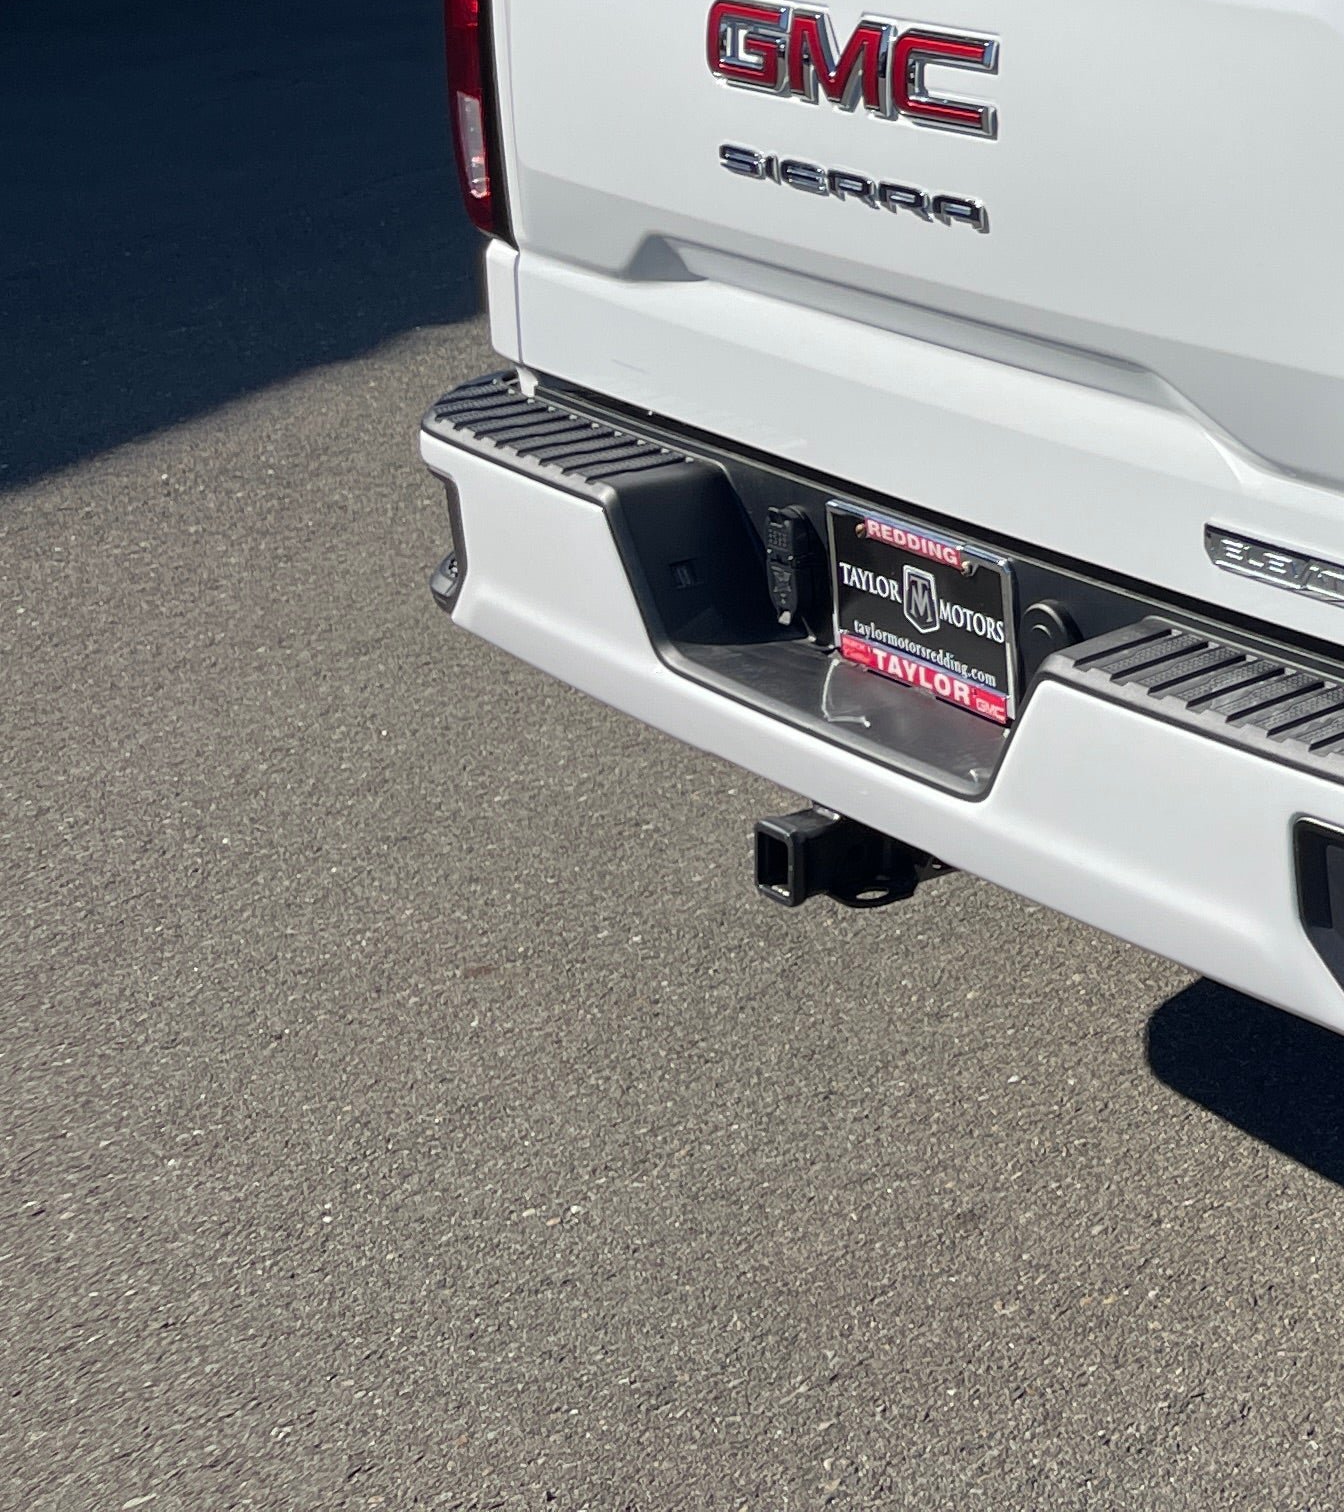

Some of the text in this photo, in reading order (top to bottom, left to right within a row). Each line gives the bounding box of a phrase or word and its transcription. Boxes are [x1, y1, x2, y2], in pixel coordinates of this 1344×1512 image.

[719, 143, 990, 233] SIERRA
[867, 519, 959, 565] REDDING
[839, 562, 902, 604] TAYLOR
[938, 598, 1005, 644] MOTORS
[853, 619, 997, 688] taylormotorsredding.com
[872, 647, 971, 706] TAYLOR
[975, 697, 1006, 722] GMC
